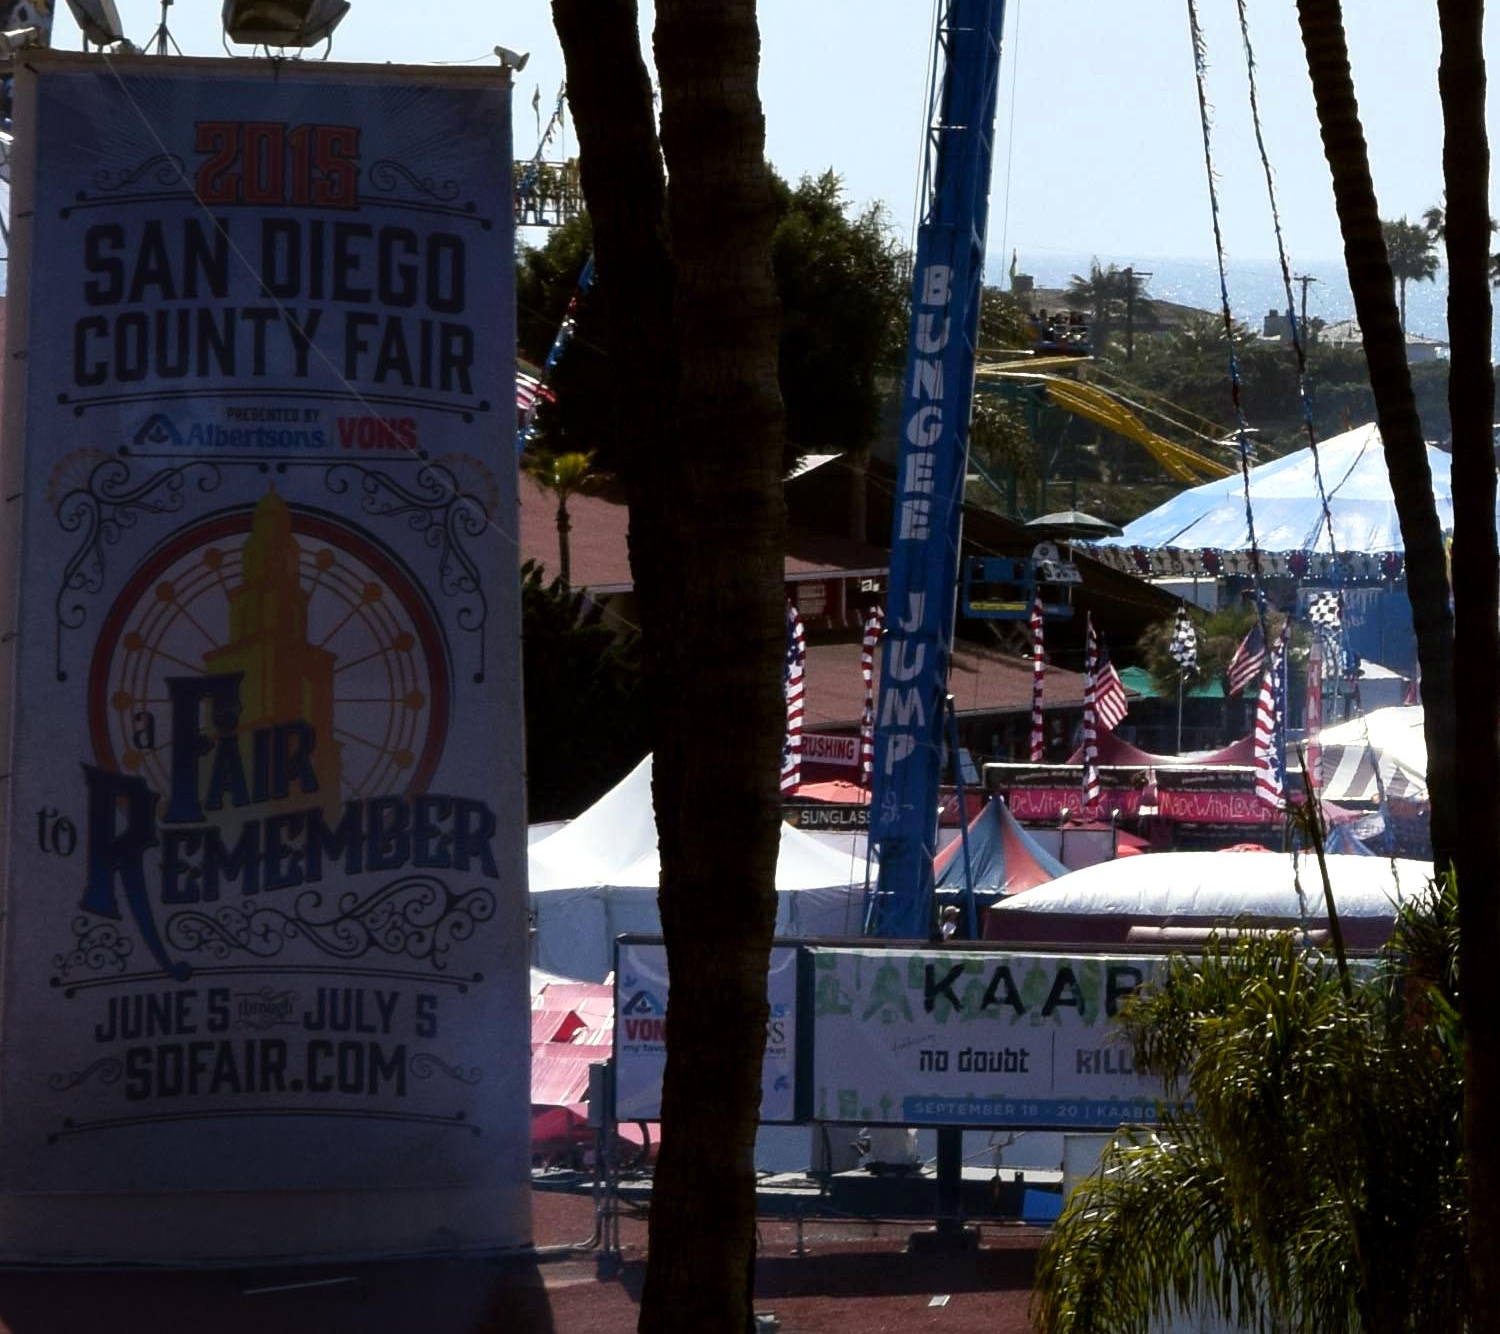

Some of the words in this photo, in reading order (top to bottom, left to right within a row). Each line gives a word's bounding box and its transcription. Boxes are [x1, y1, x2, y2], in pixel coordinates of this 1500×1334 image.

[193, 121, 362, 209] 2015
[83, 218, 230, 307] SAN
[261, 217, 467, 315] DIEGO
[73, 307, 323, 389] COUNTY
[344, 317, 475, 396] FAIR
[225, 409, 301, 422] PRESENTED
[304, 409, 320, 422] BY
[898, 265, 952, 541] BUNGEE
[186, 422, 326, 449] Albertsons
[337, 416, 418, 449] VONS
[880, 591, 928, 775] JUMP
[133, 710, 155, 751] a
[165, 672, 319, 823] FAIR
[36, 807, 78, 857] to
[80, 763, 498, 979] REMEMBER
[95, 989, 198, 1042] JUNE
[207, 986, 229, 1029] 5
[304, 987, 399, 1035] JULY
[417, 994, 438, 1038] 5
[625, 1020, 667, 1042] VON
[124, 1038, 407, 1101] SDFAIR.COM
[920, 1050, 949, 1073] no
[958, 1047, 1029, 1074] doubt
[913, 1102, 1015, 1118] SEPTEMBER
[1021, 1103, 1038, 1118] 18
[1059, 1104, 1079, 1118] 20
